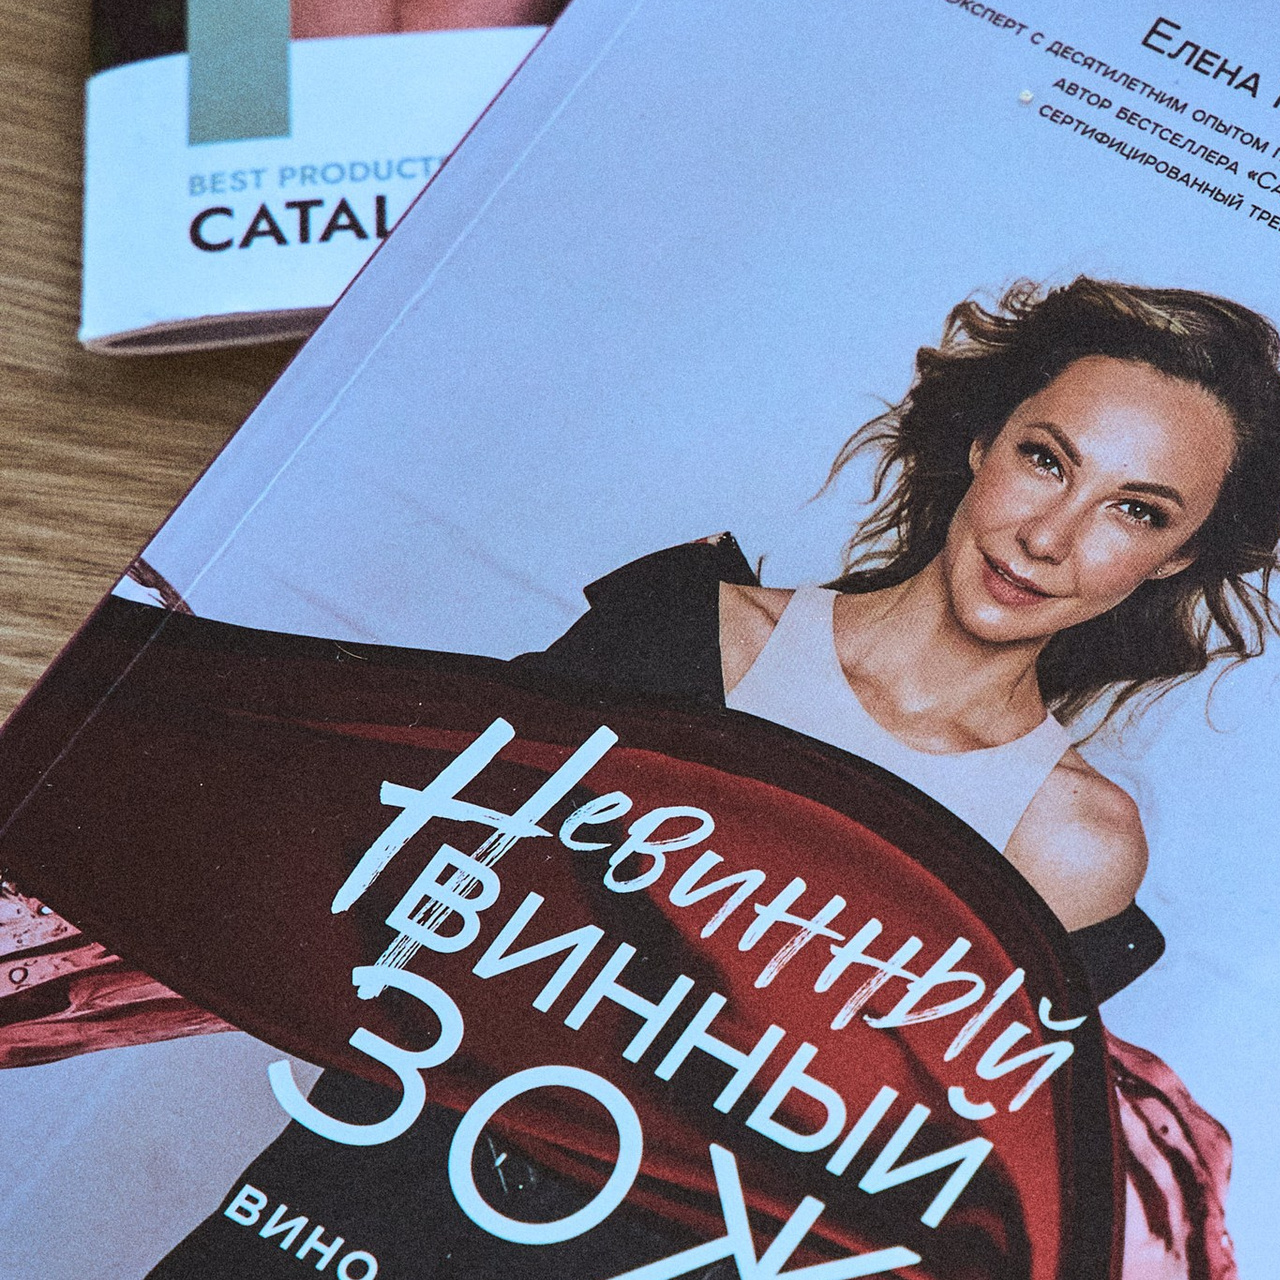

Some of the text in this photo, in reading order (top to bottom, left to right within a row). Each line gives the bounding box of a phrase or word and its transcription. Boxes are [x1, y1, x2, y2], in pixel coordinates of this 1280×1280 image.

[189, 155, 446, 197] BEST PRODUCT
[385, 843, 995, 1229] ВИННЫЙ
